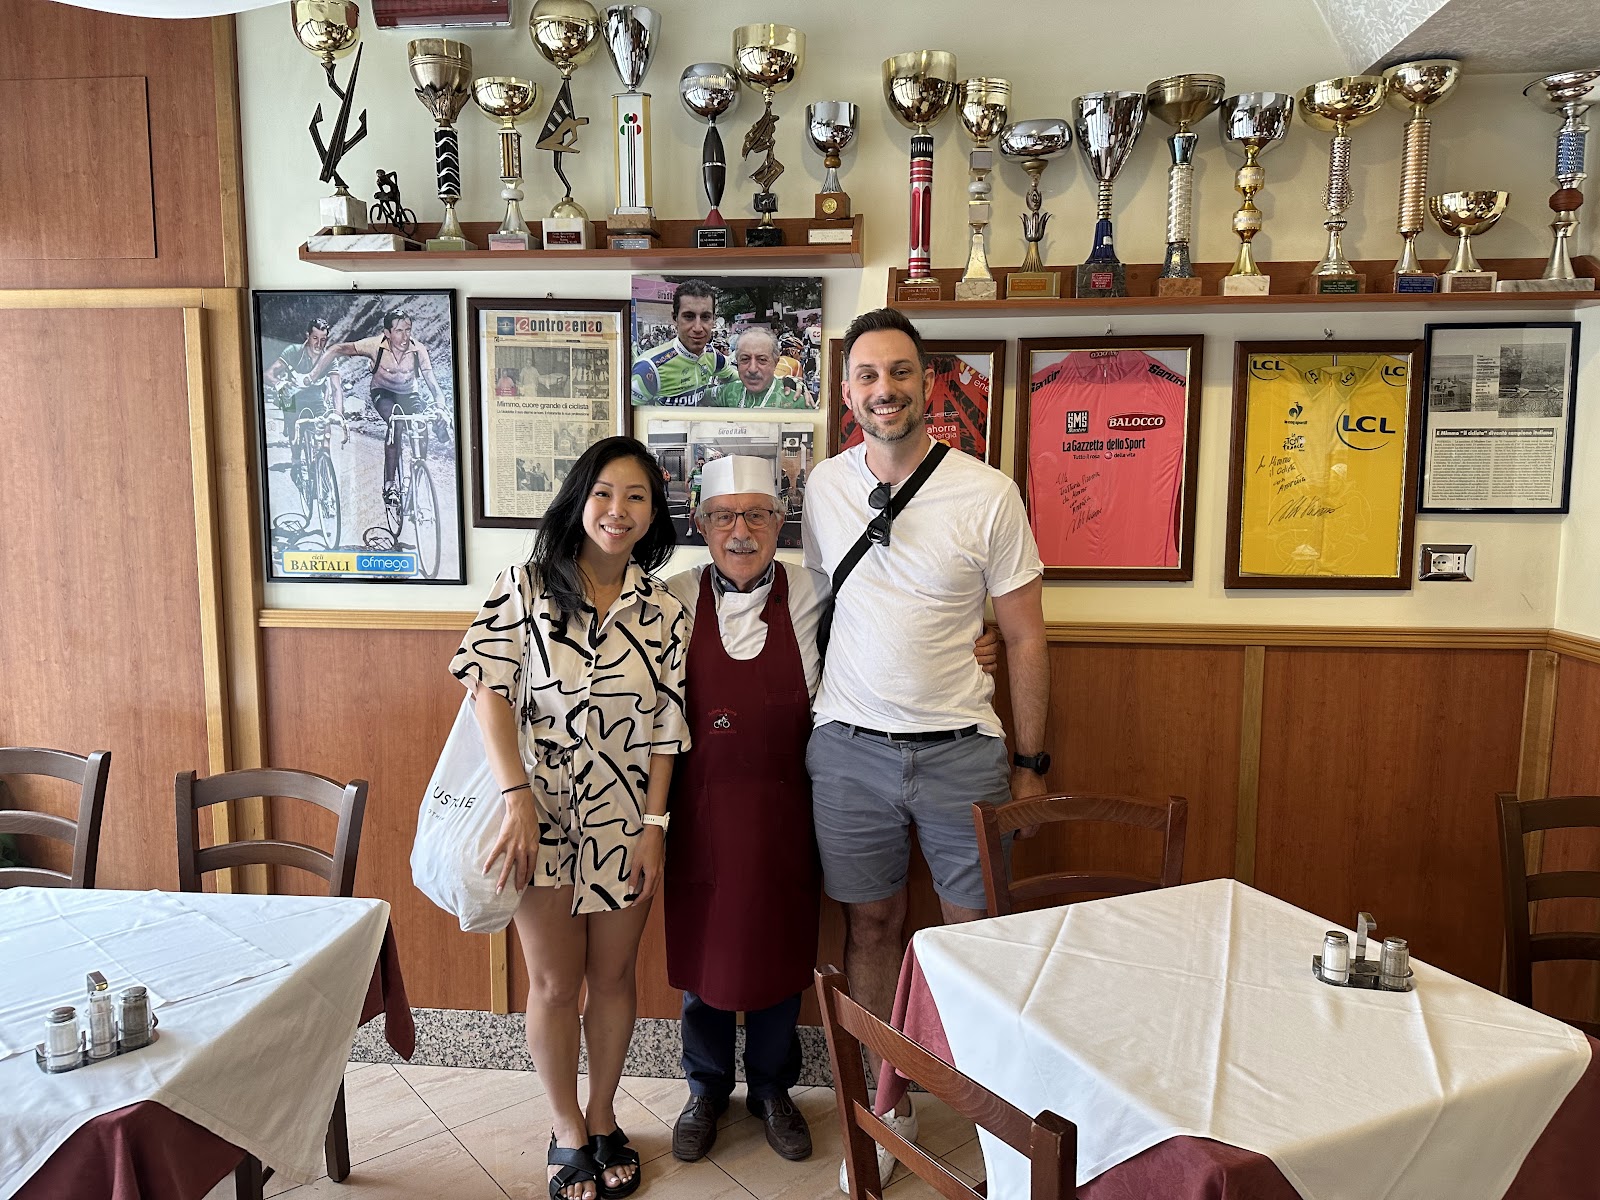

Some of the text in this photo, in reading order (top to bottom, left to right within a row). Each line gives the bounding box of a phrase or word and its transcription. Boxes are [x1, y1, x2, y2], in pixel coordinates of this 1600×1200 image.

[1252, 360, 1285, 371] LCL
[1384, 366, 1406, 377] LC
[1308, 369, 1319, 384] LCL
[1341, 371, 1355, 384] LCL
[496, 401, 521, 409] Mimmo,
[539, 402, 561, 410] grande
[568, 402, 589, 410] ciclista
[665, 391, 705, 406] LIQUIG
[1067, 411, 1088, 428] SMS
[1108, 416, 1164, 427] BALOCCO
[1342, 415, 1396, 434] LCL
[926, 424, 957, 434] ahorra
[1062, 437, 1146, 452] La Gazzetta dello Sport
[290, 556, 410, 572] BARTALI ofmega
